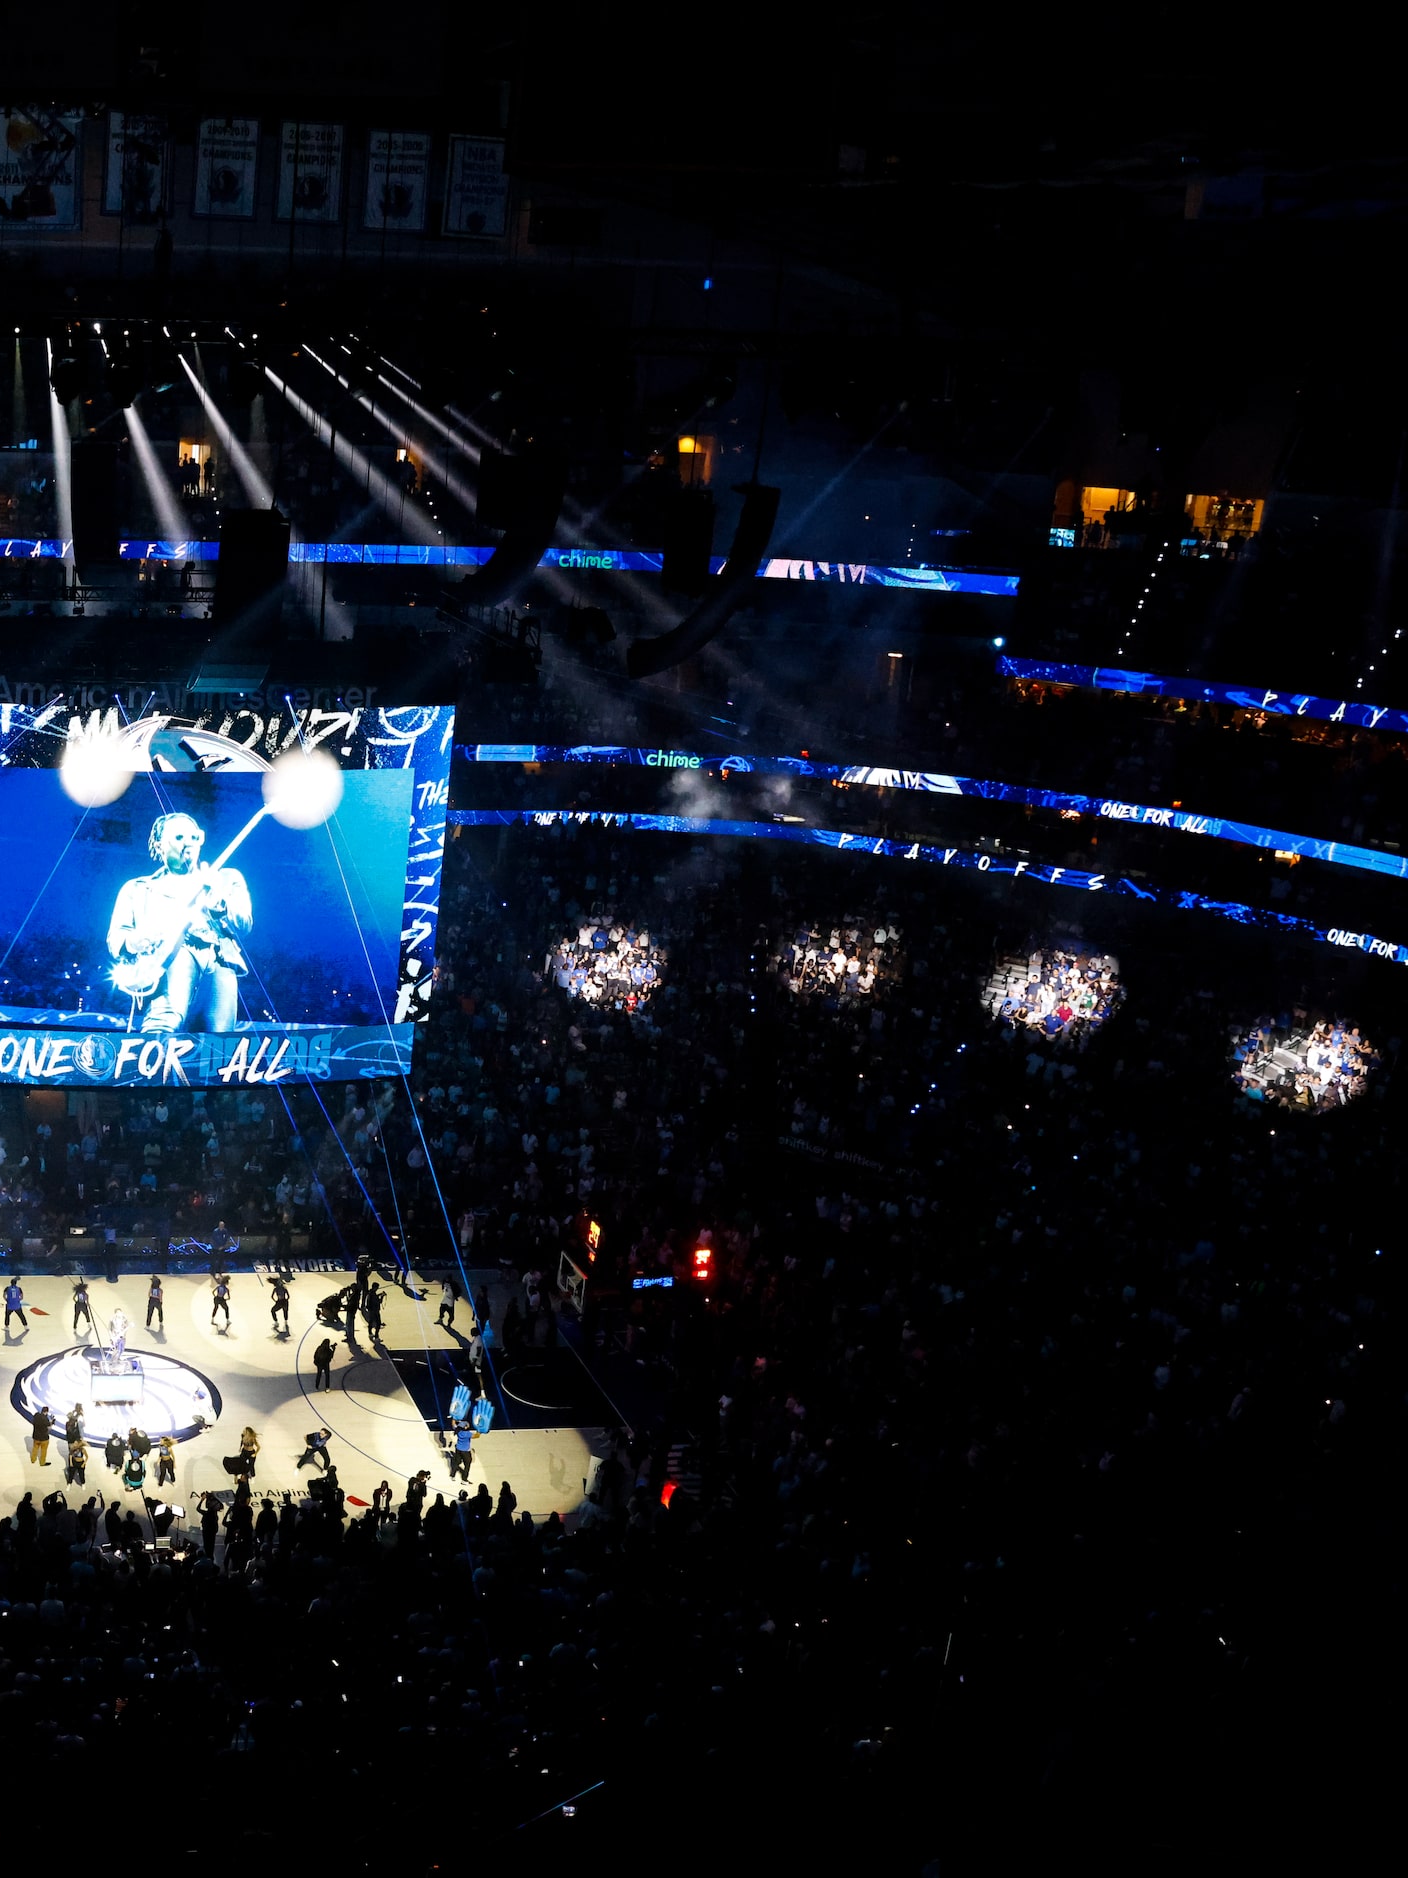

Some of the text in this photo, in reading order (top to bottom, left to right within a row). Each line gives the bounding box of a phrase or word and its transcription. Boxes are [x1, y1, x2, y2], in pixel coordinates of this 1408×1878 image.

[559, 550, 613, 570] chime
[646, 749, 701, 769] chime
[1100, 802, 1208, 834] ONE FOR ALL
[838, 833, 1105, 891] PLAYOFFS
[1327, 928, 1399, 961] ONE FOR
[114, 1036, 194, 1086] FOR
[218, 1036, 295, 1084] ALL
